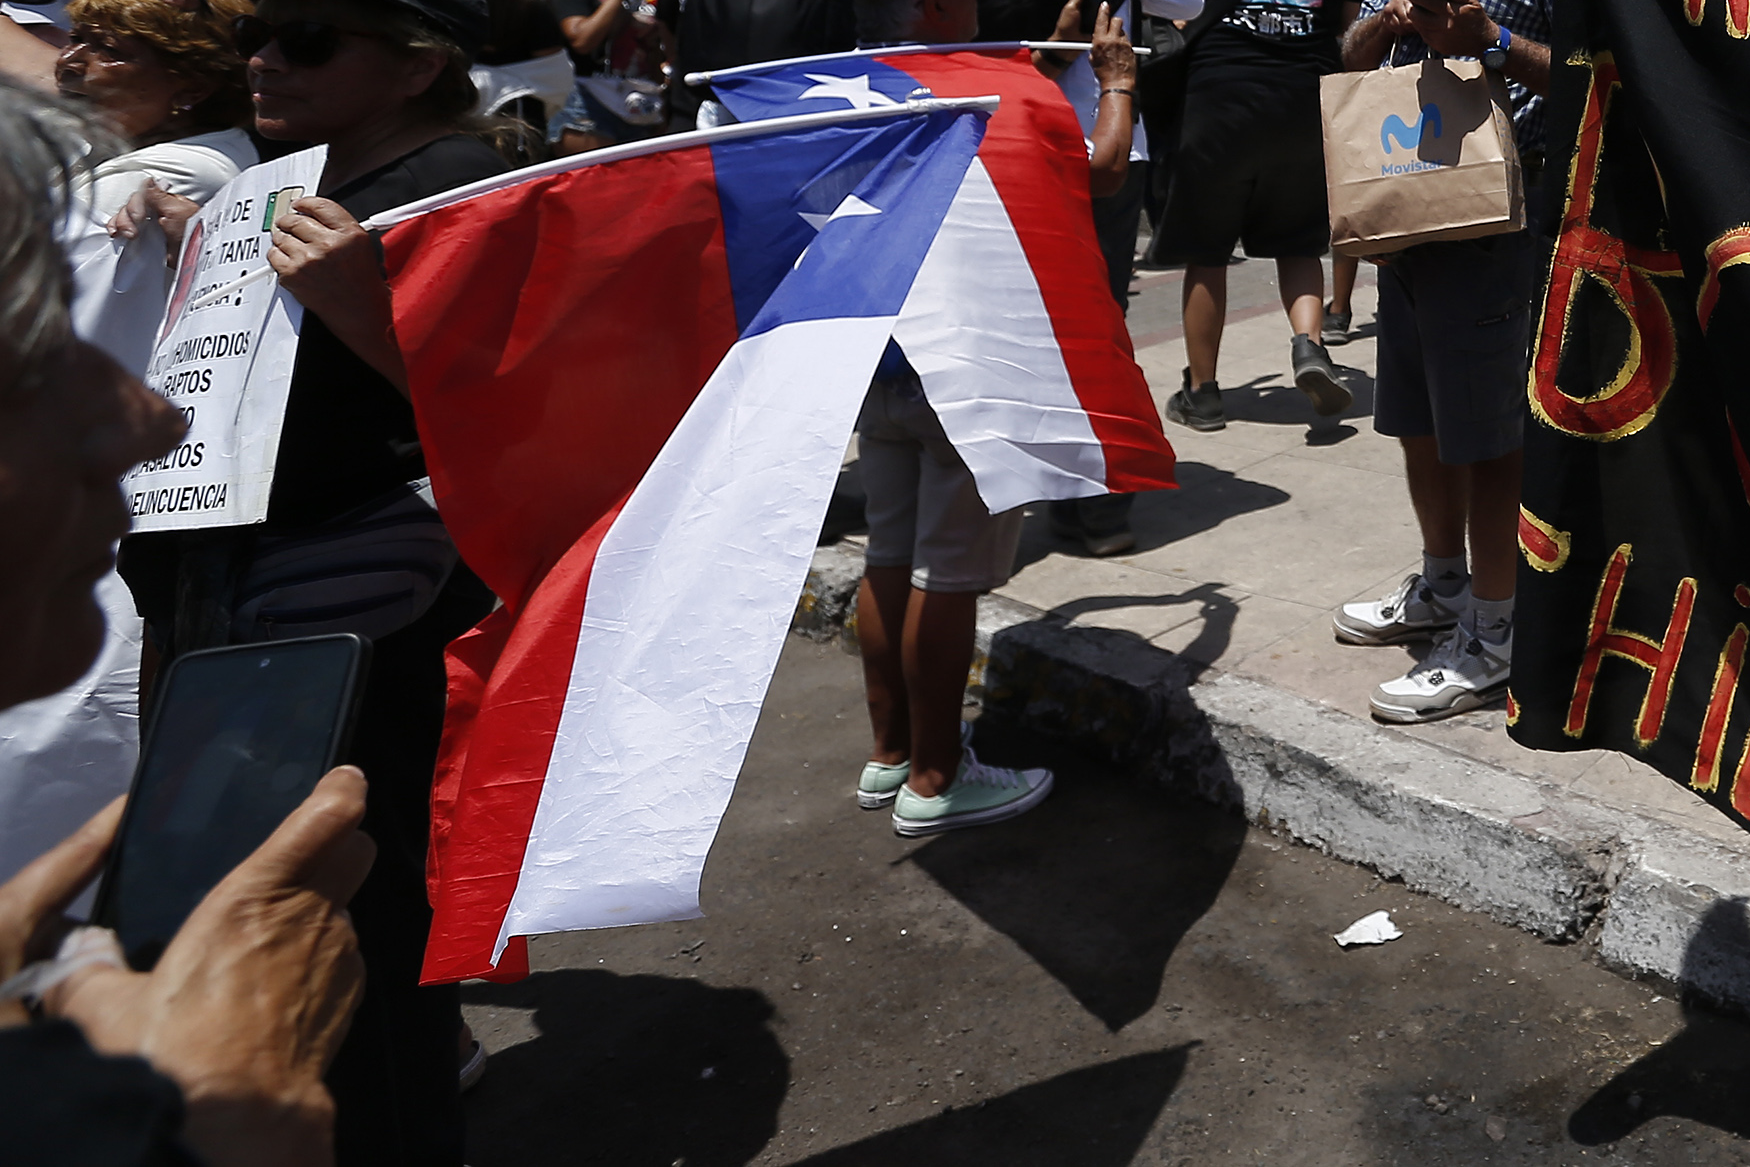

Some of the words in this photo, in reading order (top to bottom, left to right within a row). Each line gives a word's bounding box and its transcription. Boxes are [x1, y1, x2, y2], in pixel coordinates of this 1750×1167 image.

[1381, 159, 1443, 176] Movistar
[231, 198, 254, 223] DE
[218, 236, 260, 265] TANTA
[173, 330, 251, 366] HOMICIDIOS
[163, 368, 213, 398] RAPTOS
